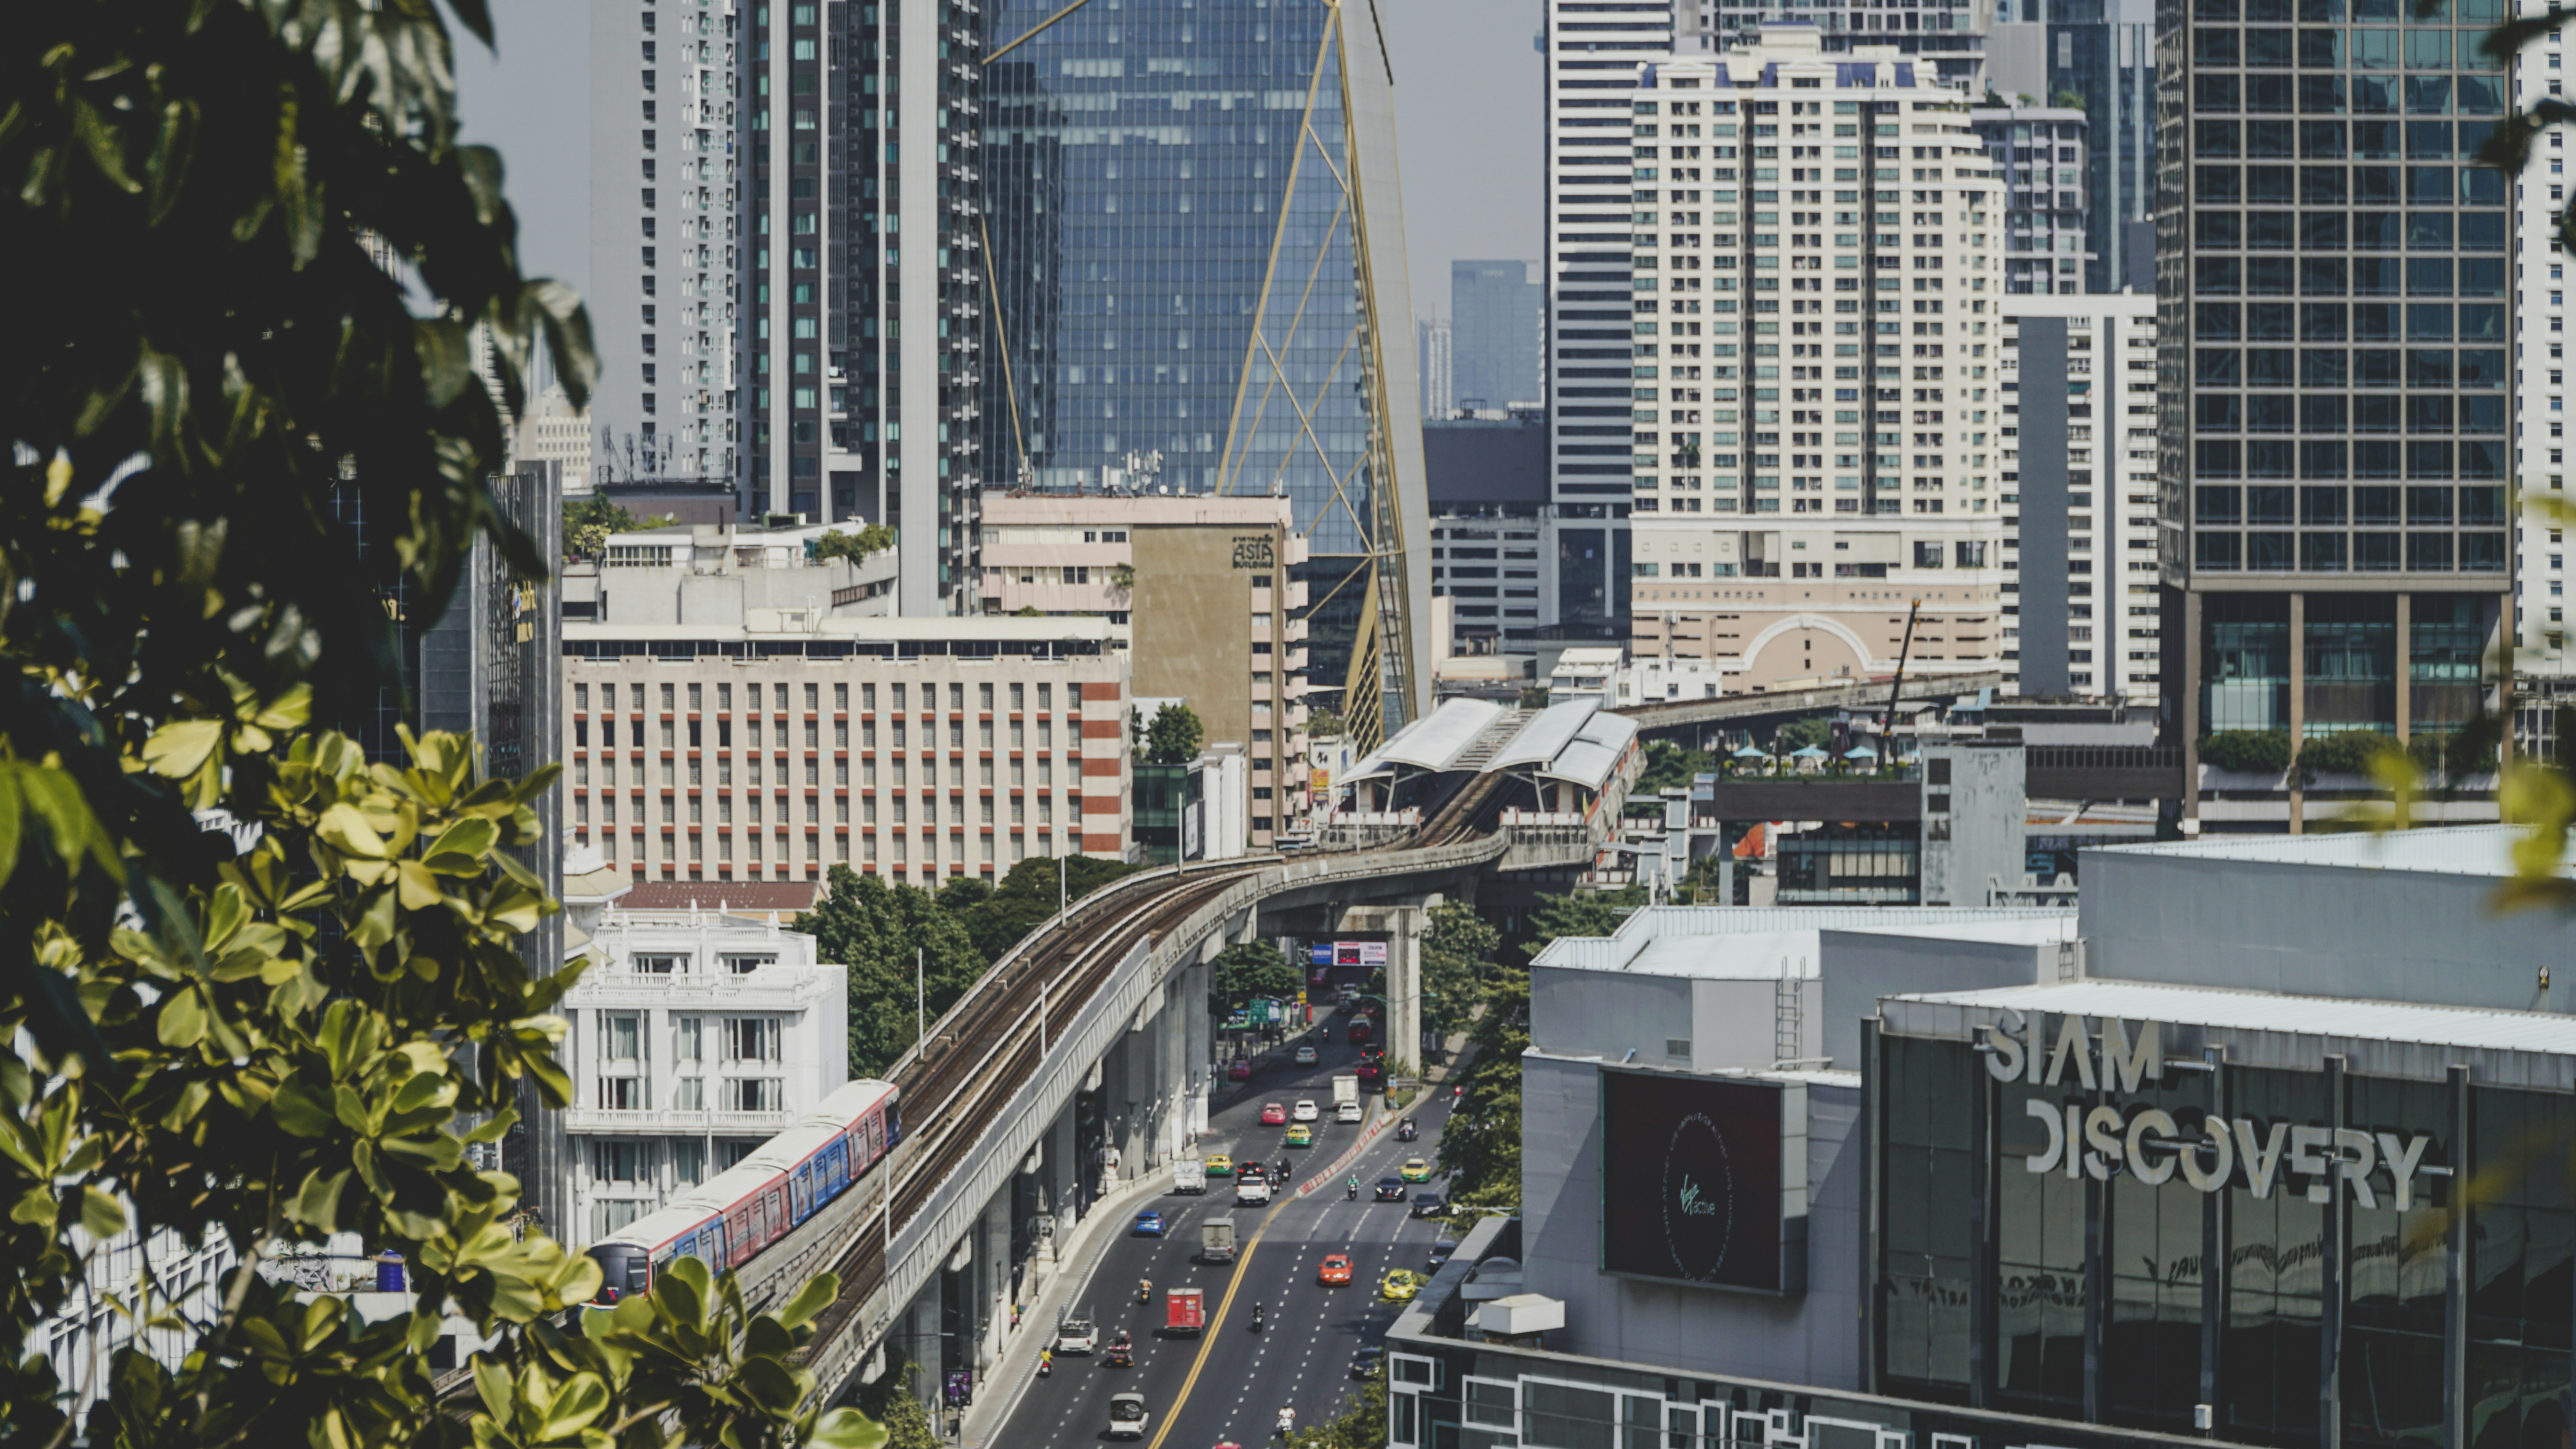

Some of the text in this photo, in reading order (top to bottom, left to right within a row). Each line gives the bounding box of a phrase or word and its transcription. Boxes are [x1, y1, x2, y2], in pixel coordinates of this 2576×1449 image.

[1233, 544, 1273, 561] ASIA
[1985, 1008, 2164, 1094] SIAM
[2026, 1098, 2433, 1212] DISCOVERY
[1693, 1199, 1715, 1215] active
